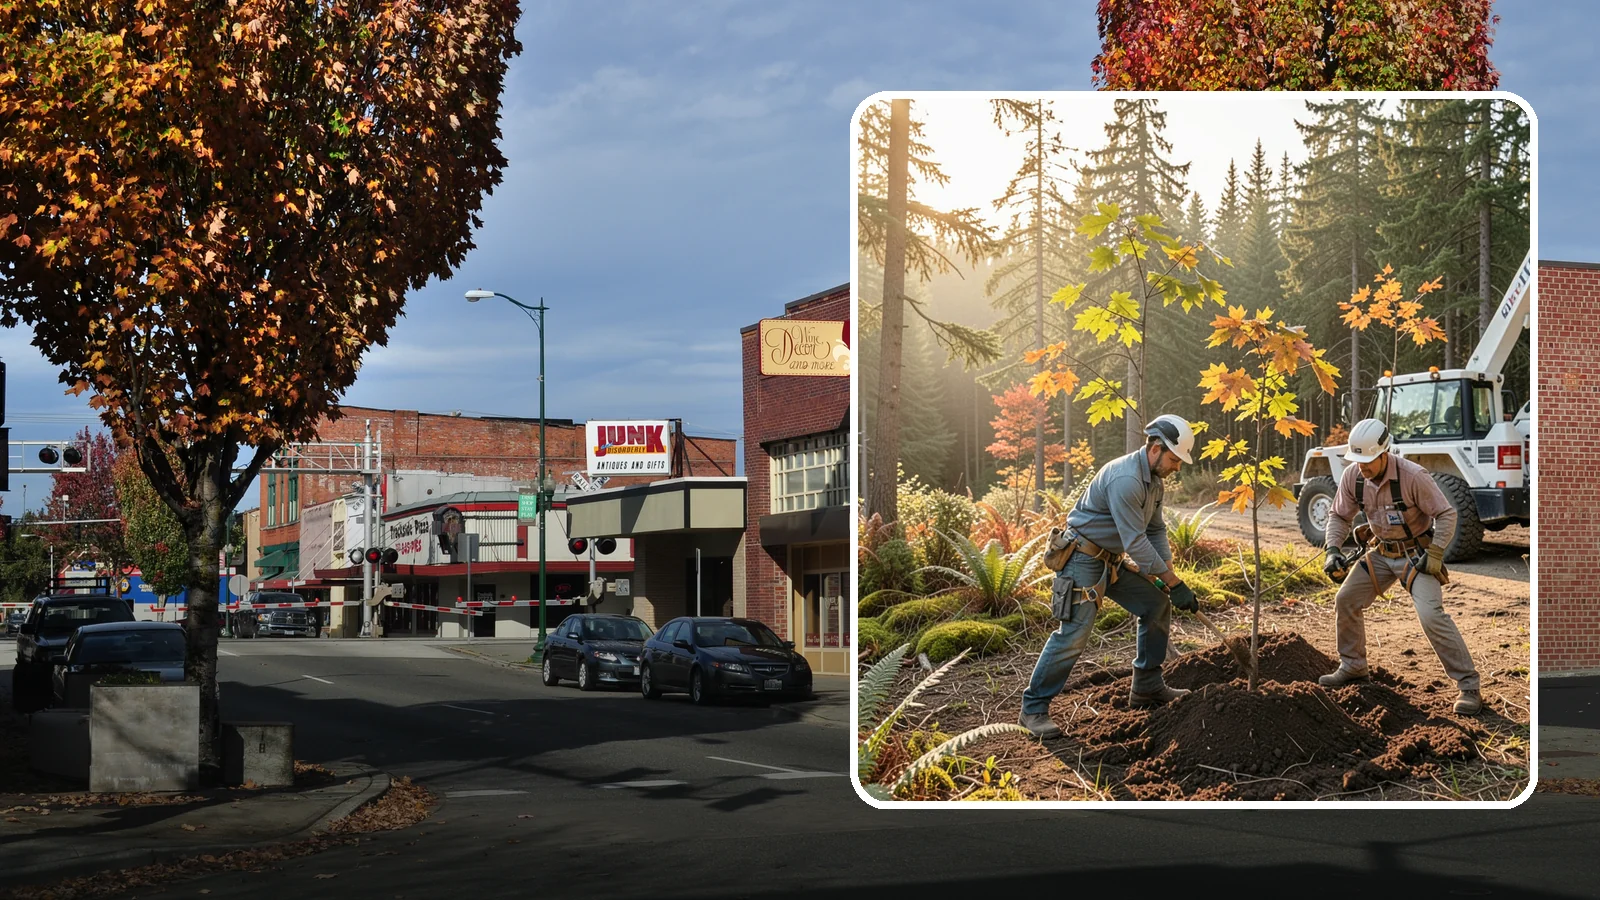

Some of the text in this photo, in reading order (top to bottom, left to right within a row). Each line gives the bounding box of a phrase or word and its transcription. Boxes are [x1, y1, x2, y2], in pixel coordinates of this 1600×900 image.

[791, 325, 823, 345] Wine
[595, 425, 665, 457] JUNK
[607, 446, 646, 454] DISORDERLY
[597, 460, 665, 470] ANTIQUES AND GIFTS
[573, 473, 589, 491] RAIL
